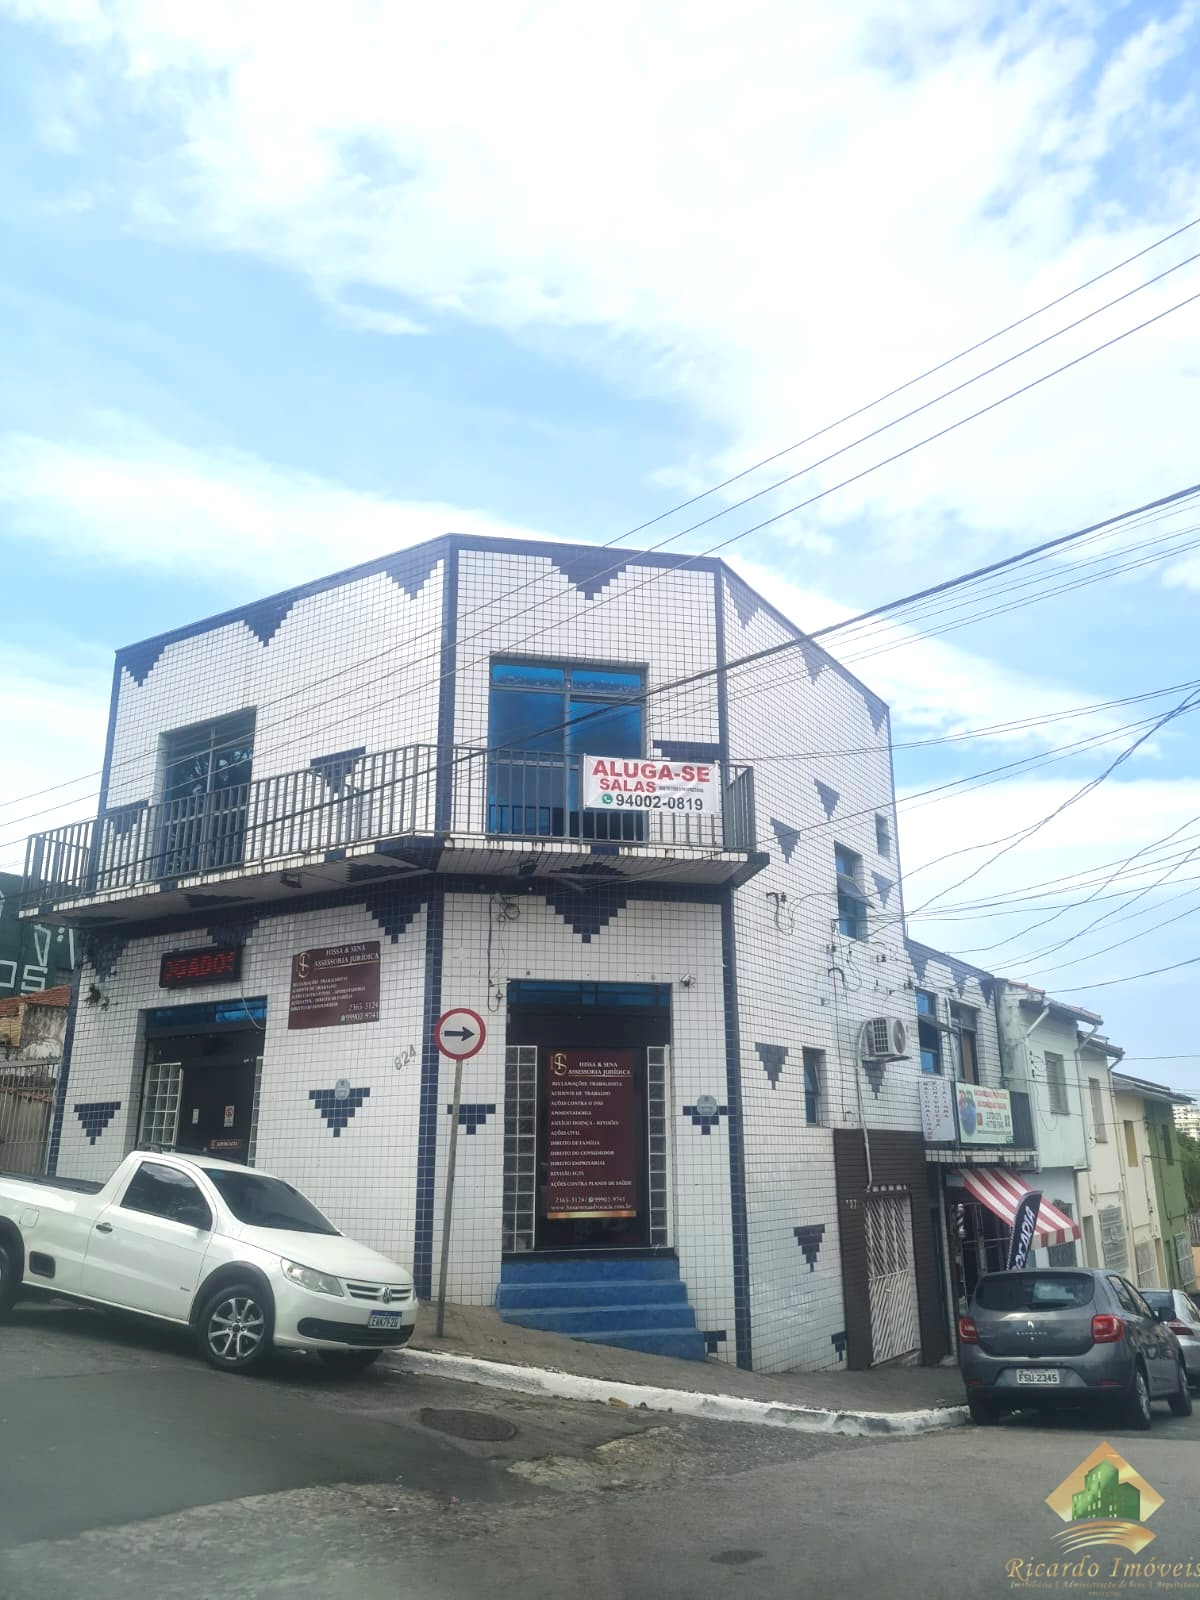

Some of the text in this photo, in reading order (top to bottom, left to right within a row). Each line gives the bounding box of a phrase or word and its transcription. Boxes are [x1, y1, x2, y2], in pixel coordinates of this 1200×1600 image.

[592, 760, 711, 783] ALUGA-SE
[600, 778, 656, 794] SALAS
[616, 793, 703, 811] 94002-0819
